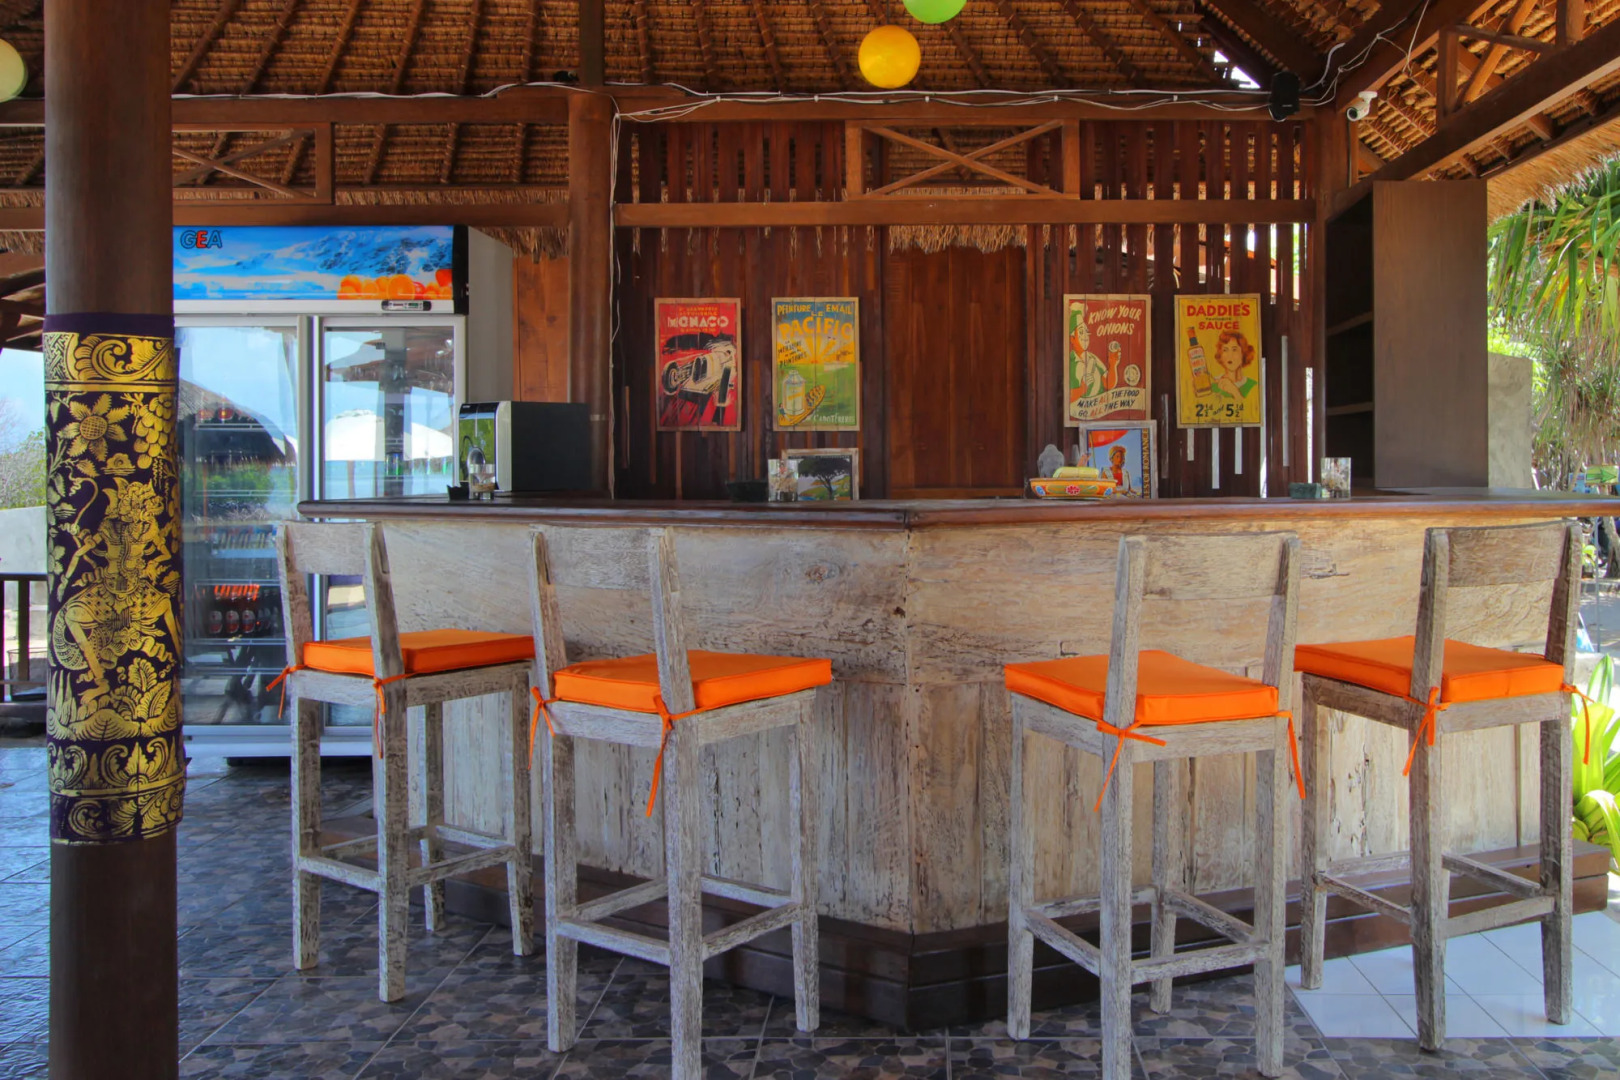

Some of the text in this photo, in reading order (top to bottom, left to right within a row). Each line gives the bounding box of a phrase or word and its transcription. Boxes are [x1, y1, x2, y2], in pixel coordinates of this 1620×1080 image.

[180, 230, 223, 249] GEA
[826, 304, 852, 315] EMAIL
[1088, 304, 1142, 325] KNOW YOUR
[1186, 302, 1251, 317] DADDIE'S
[667, 316, 729, 328] MONACO
[778, 316, 853, 340] PACIFIC
[1096, 322, 1135, 337] ONIONS
[1198, 321, 1240, 330] SAUCE
[1077, 398, 1099, 408] MAKE
[1111, 390, 1124, 400] THE
[1124, 389, 1140, 399] FOOD
[1104, 401, 1119, 412] THE
[1120, 399, 1136, 408] WAY
